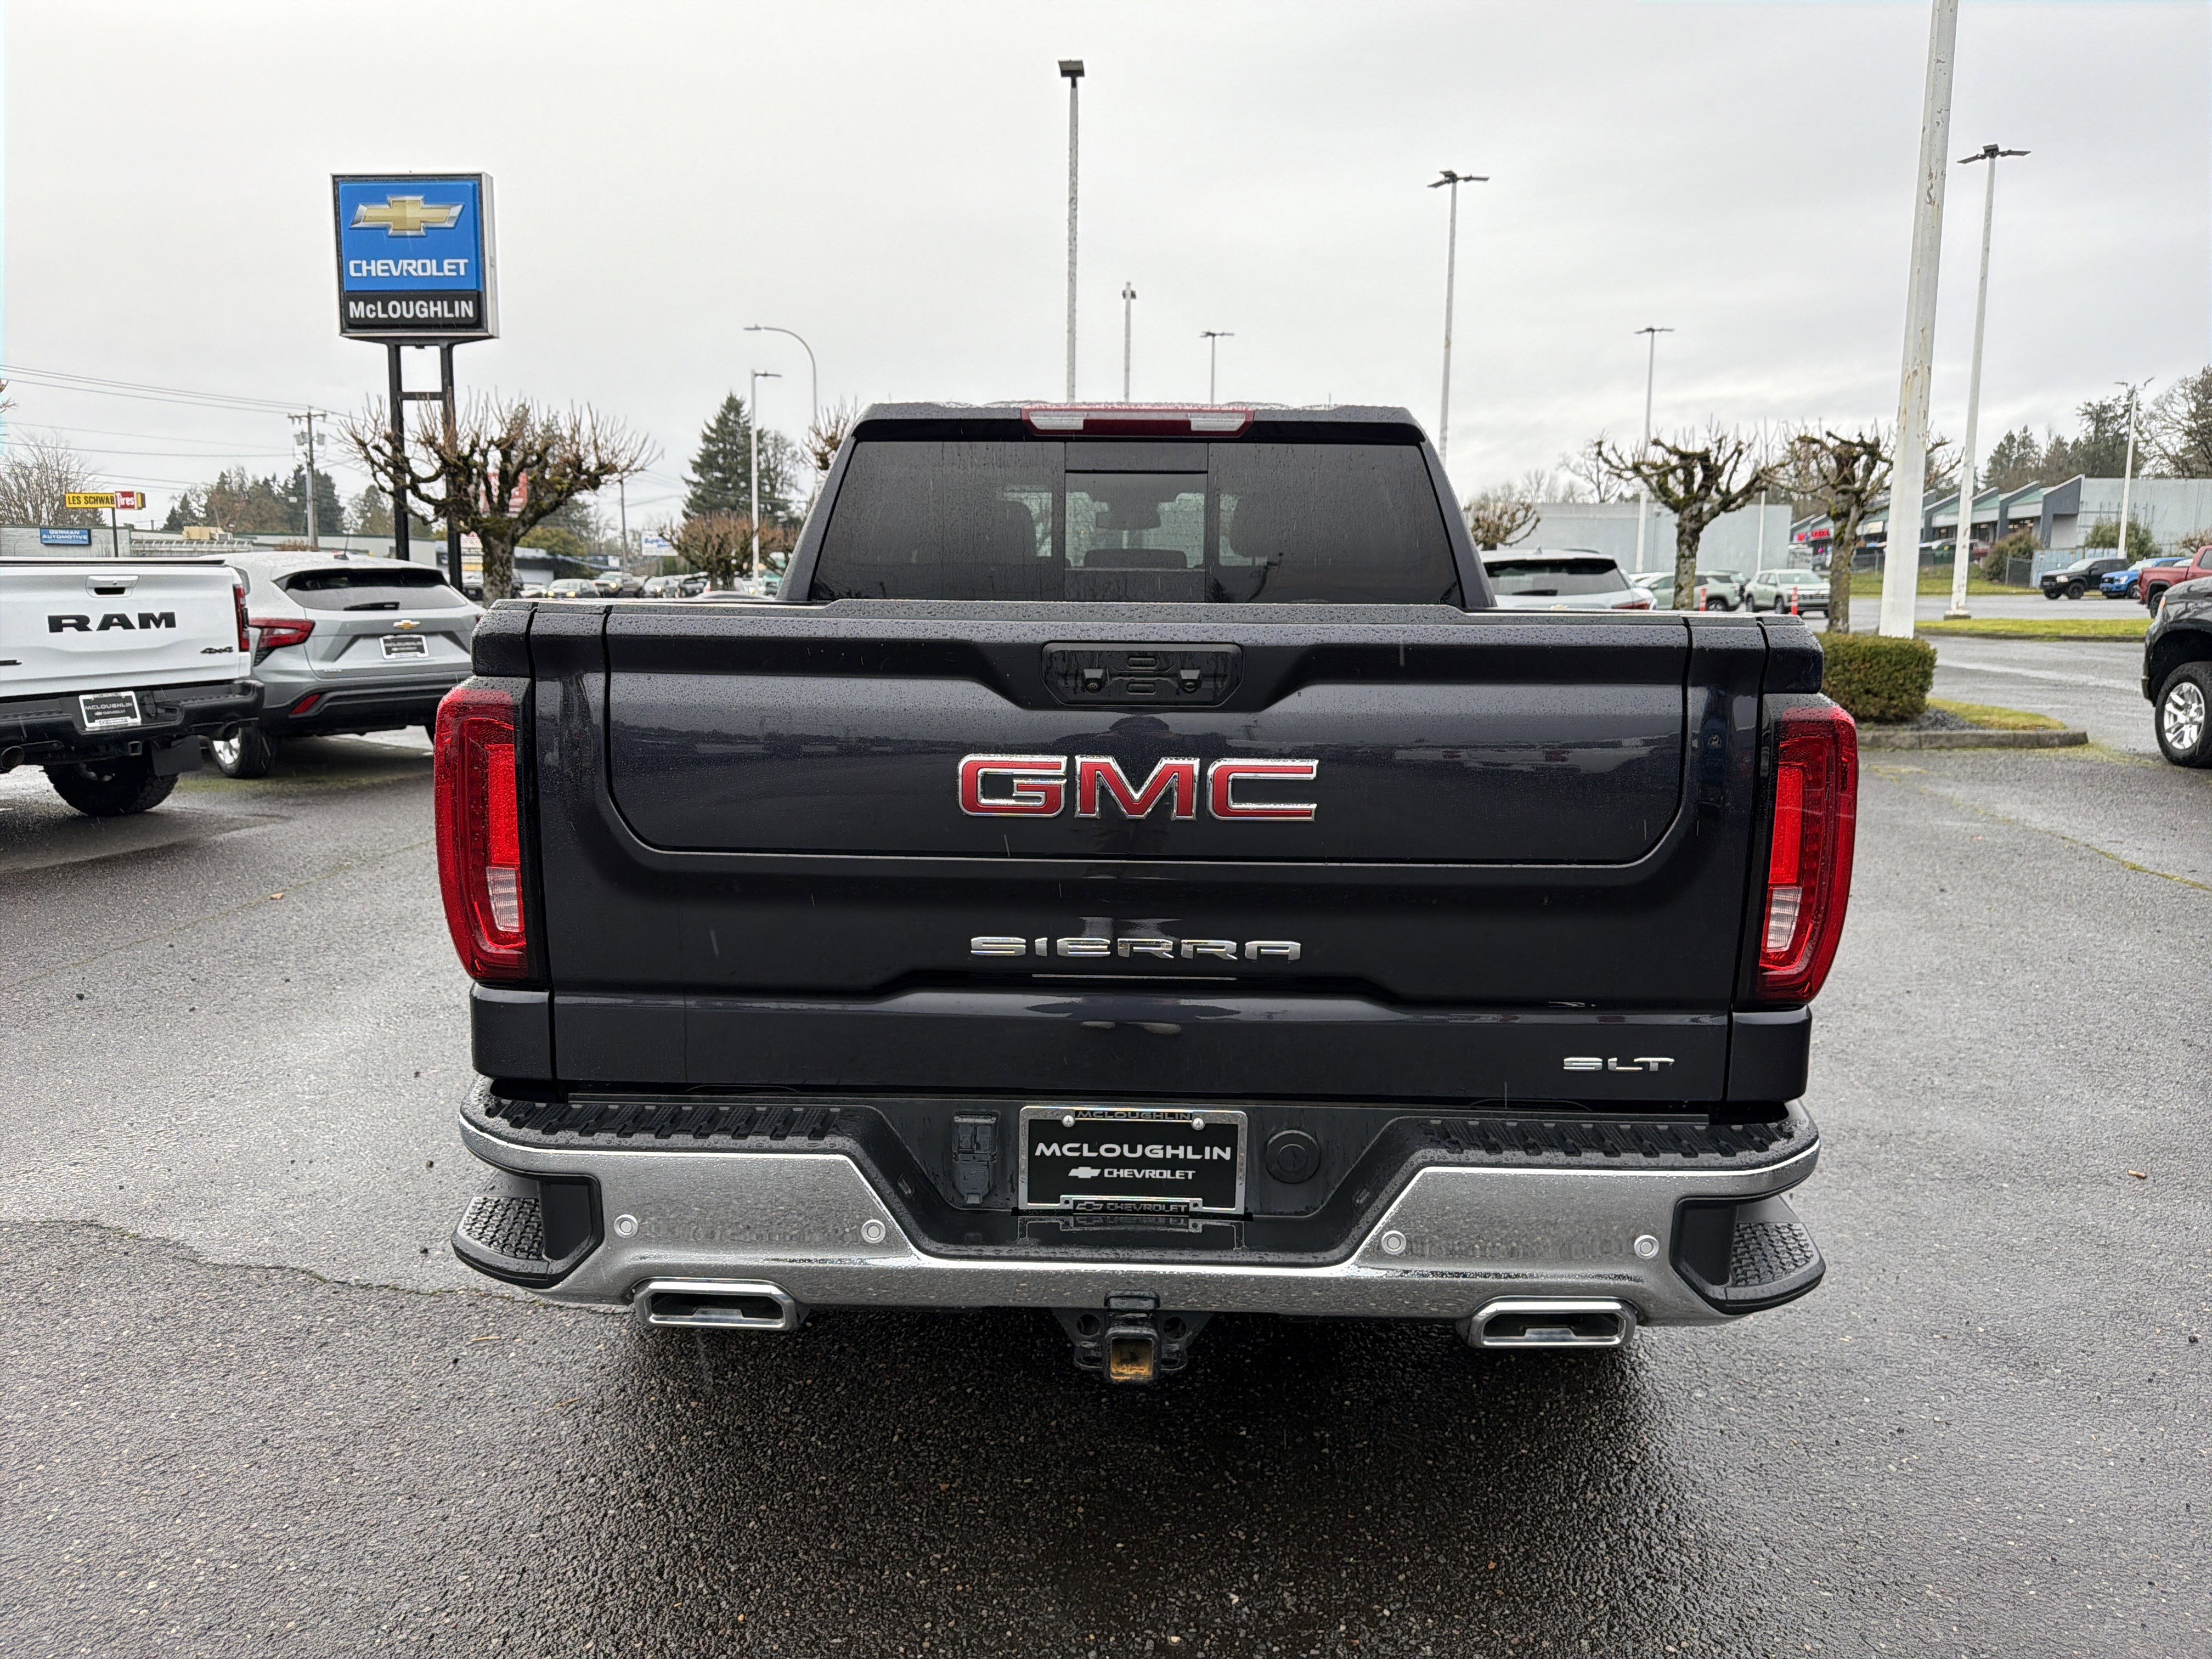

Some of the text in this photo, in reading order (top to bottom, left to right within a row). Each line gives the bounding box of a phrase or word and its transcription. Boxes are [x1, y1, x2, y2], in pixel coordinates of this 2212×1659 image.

[349, 258, 469, 277] CHEVROLET
[349, 300, 474, 319] McLOUGHLIN
[67, 492, 135, 508] LES SCHWAB Tires
[47, 611, 177, 633] RAM
[958, 753, 1319, 822] GMC
[970, 936, 1301, 961] SIERRA
[1563, 1057, 1675, 1071] SLT
[1076, 1109, 1192, 1121] MCLOUGHLIN
[1034, 1142, 1232, 1161] MCLOUGHLIN
[1103, 1168, 1196, 1180] CHEVROLET
[1106, 1201, 1188, 1214] CHEVROLET
